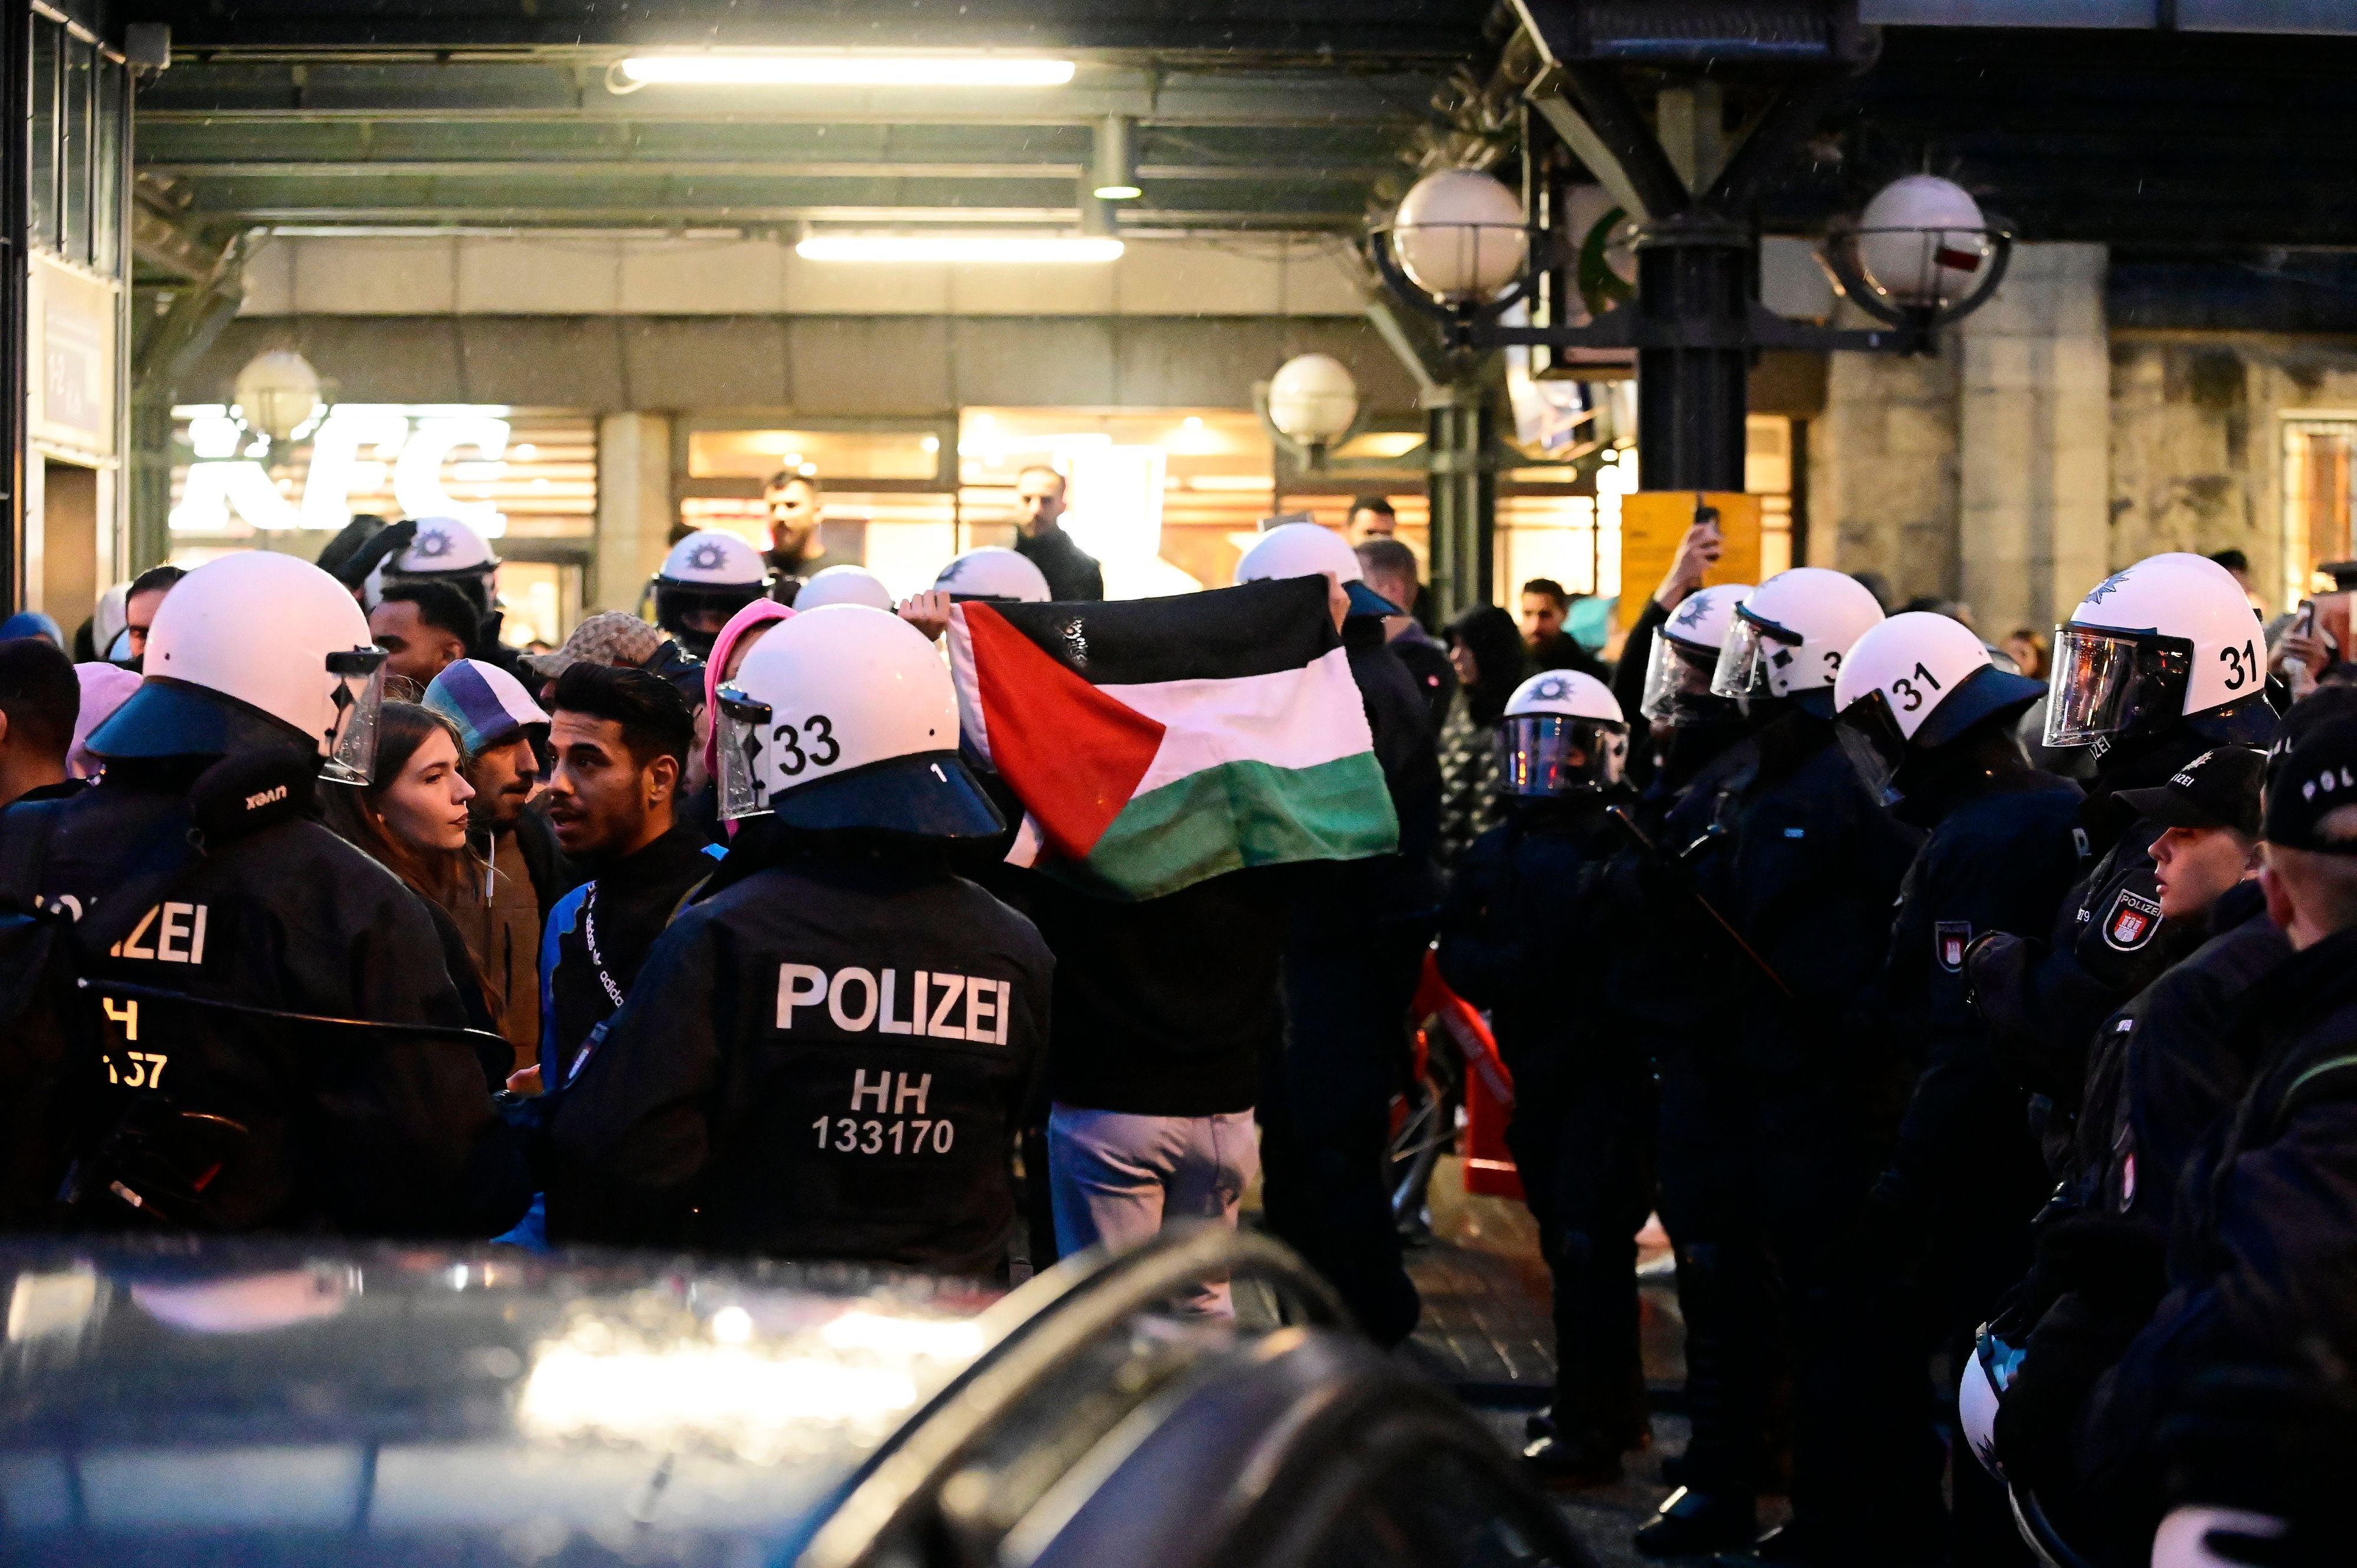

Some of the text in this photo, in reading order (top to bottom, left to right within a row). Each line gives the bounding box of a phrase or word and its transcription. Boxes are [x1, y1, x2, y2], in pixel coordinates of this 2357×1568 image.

[169, 417, 510, 530] KFC
[1893, 662, 1941, 711] 31
[2220, 640, 2256, 690] 31
[774, 715, 840, 775] 33
[776, 963, 1011, 1046] POLIZEI
[851, 1069, 932, 1114] HH
[812, 1116, 954, 1155] 133170
